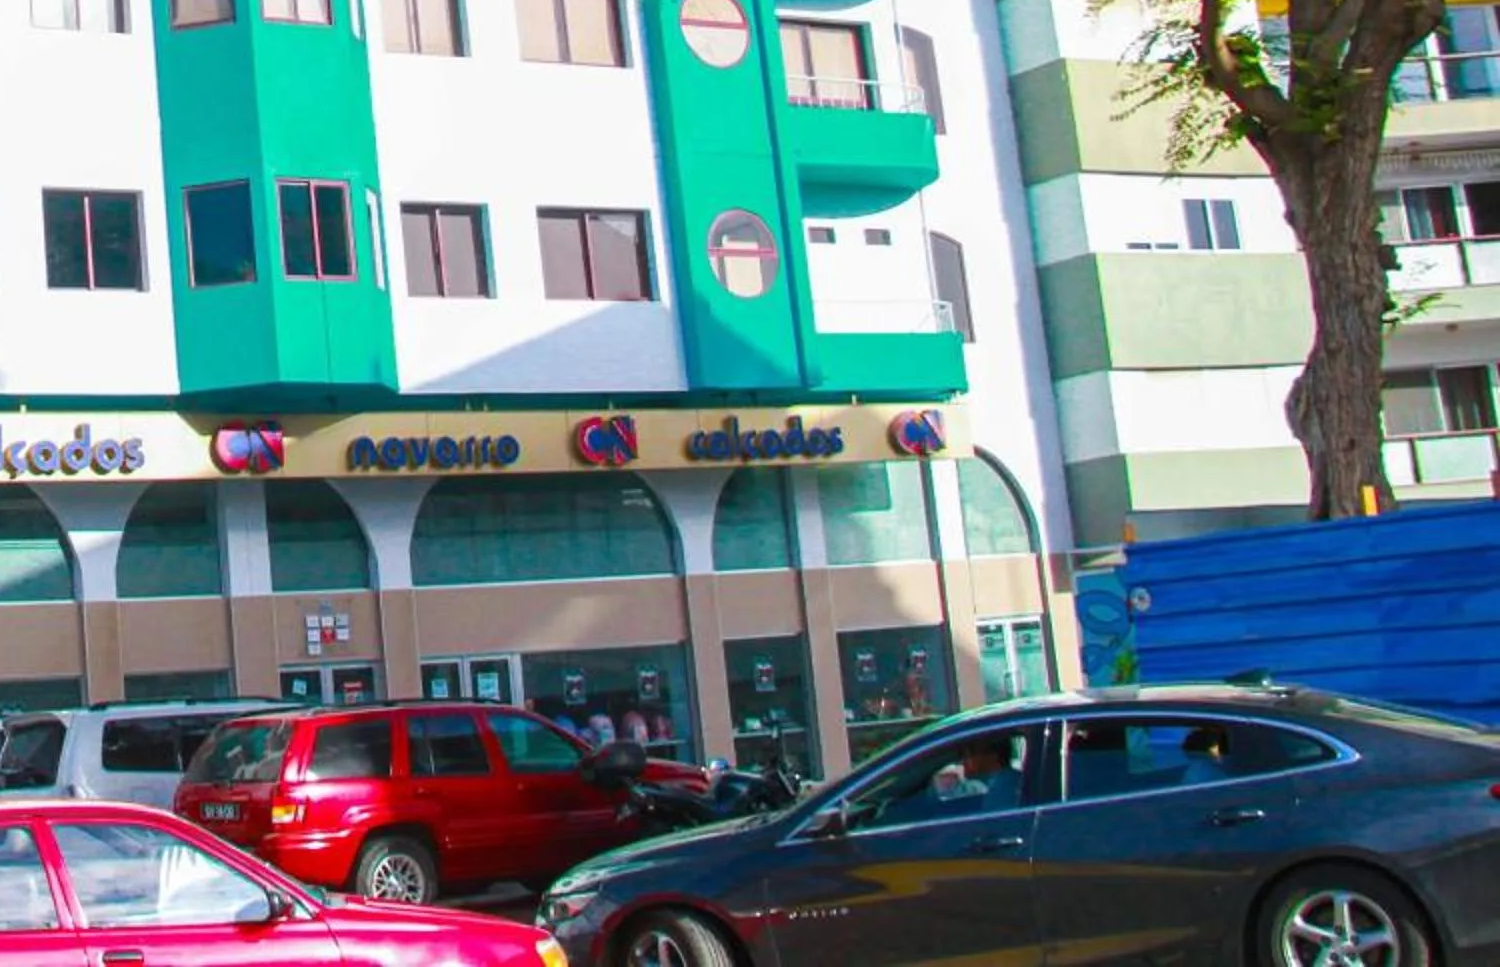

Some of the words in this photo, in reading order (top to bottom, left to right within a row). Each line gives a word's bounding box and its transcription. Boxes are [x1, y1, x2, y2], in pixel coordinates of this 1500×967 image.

[211, 418, 285, 475] CN
[347, 434, 521, 470] navarro
[576, 416, 639, 466] CN
